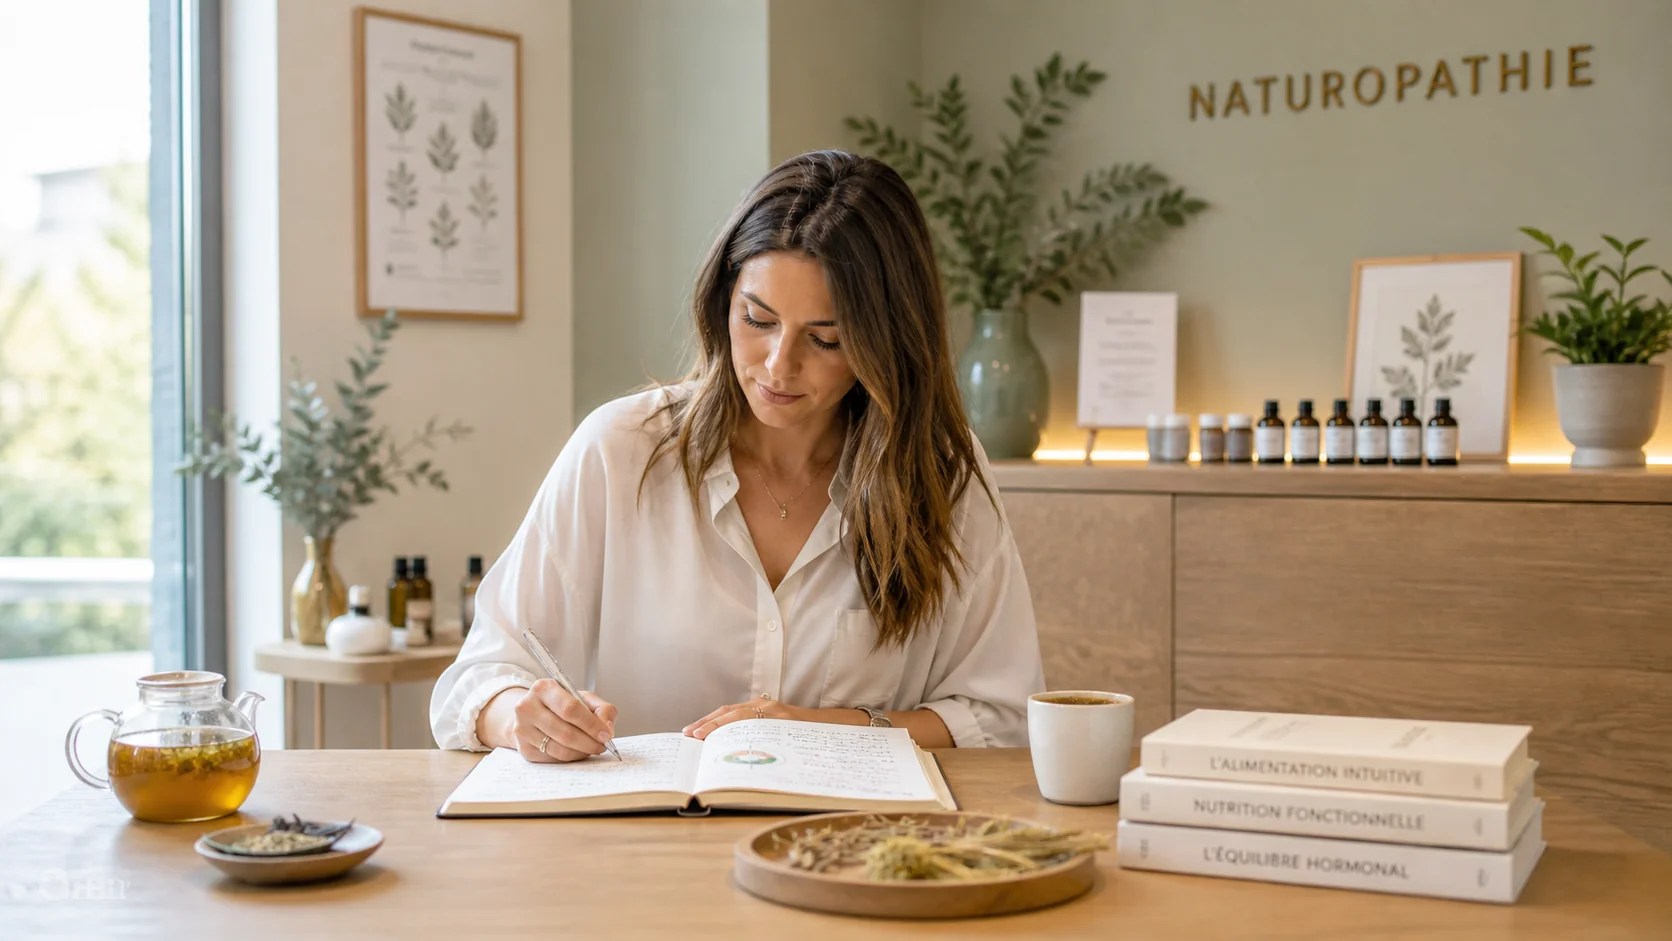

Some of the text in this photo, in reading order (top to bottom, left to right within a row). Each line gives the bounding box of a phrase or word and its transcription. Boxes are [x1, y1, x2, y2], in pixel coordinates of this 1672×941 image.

[1188, 45, 1595, 122] NATUROPATHIE
[1209, 756, 1424, 786] L'ALIMENTATION INTUITIVE
[1193, 799, 1425, 831] NUTRITION FONCTIONNELLE
[1204, 846, 1409, 880] L'ÉQUILIBRE HORMONAL
